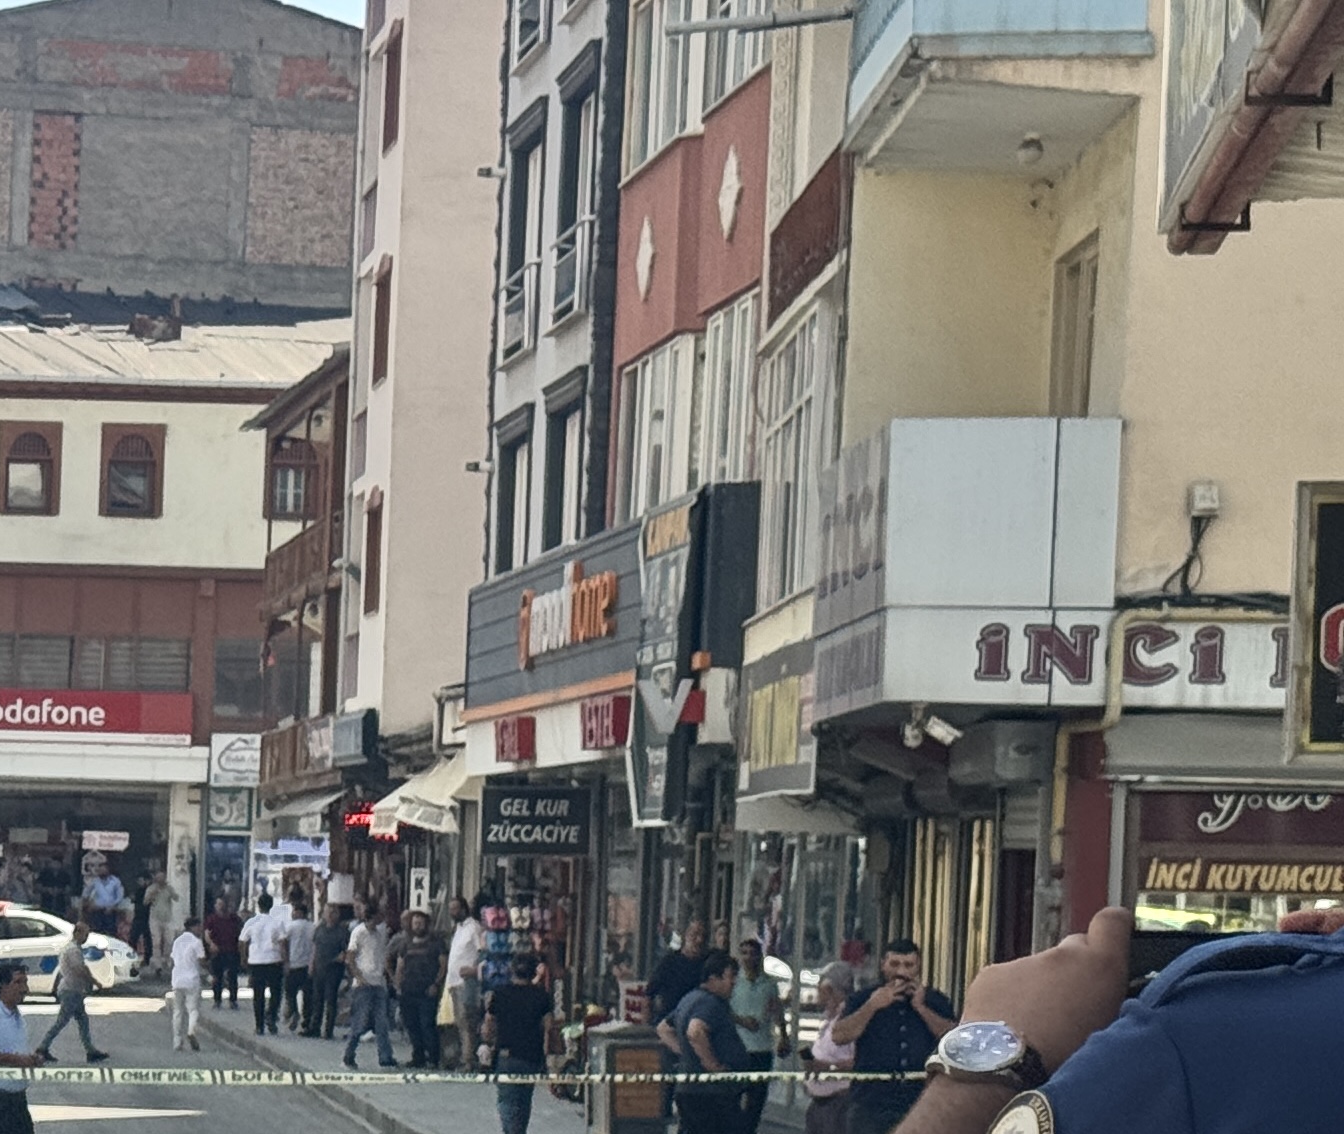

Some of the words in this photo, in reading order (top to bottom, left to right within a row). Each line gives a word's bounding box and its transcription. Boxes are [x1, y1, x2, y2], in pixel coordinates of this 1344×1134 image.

[499, 798, 531, 817] GEL
[534, 797, 570, 817] KUR
[486, 819, 581, 844] ZÜCCACİYE
[1145, 857, 1202, 890] İNCİ
[1205, 862, 1344, 892] KUYUMCUL
